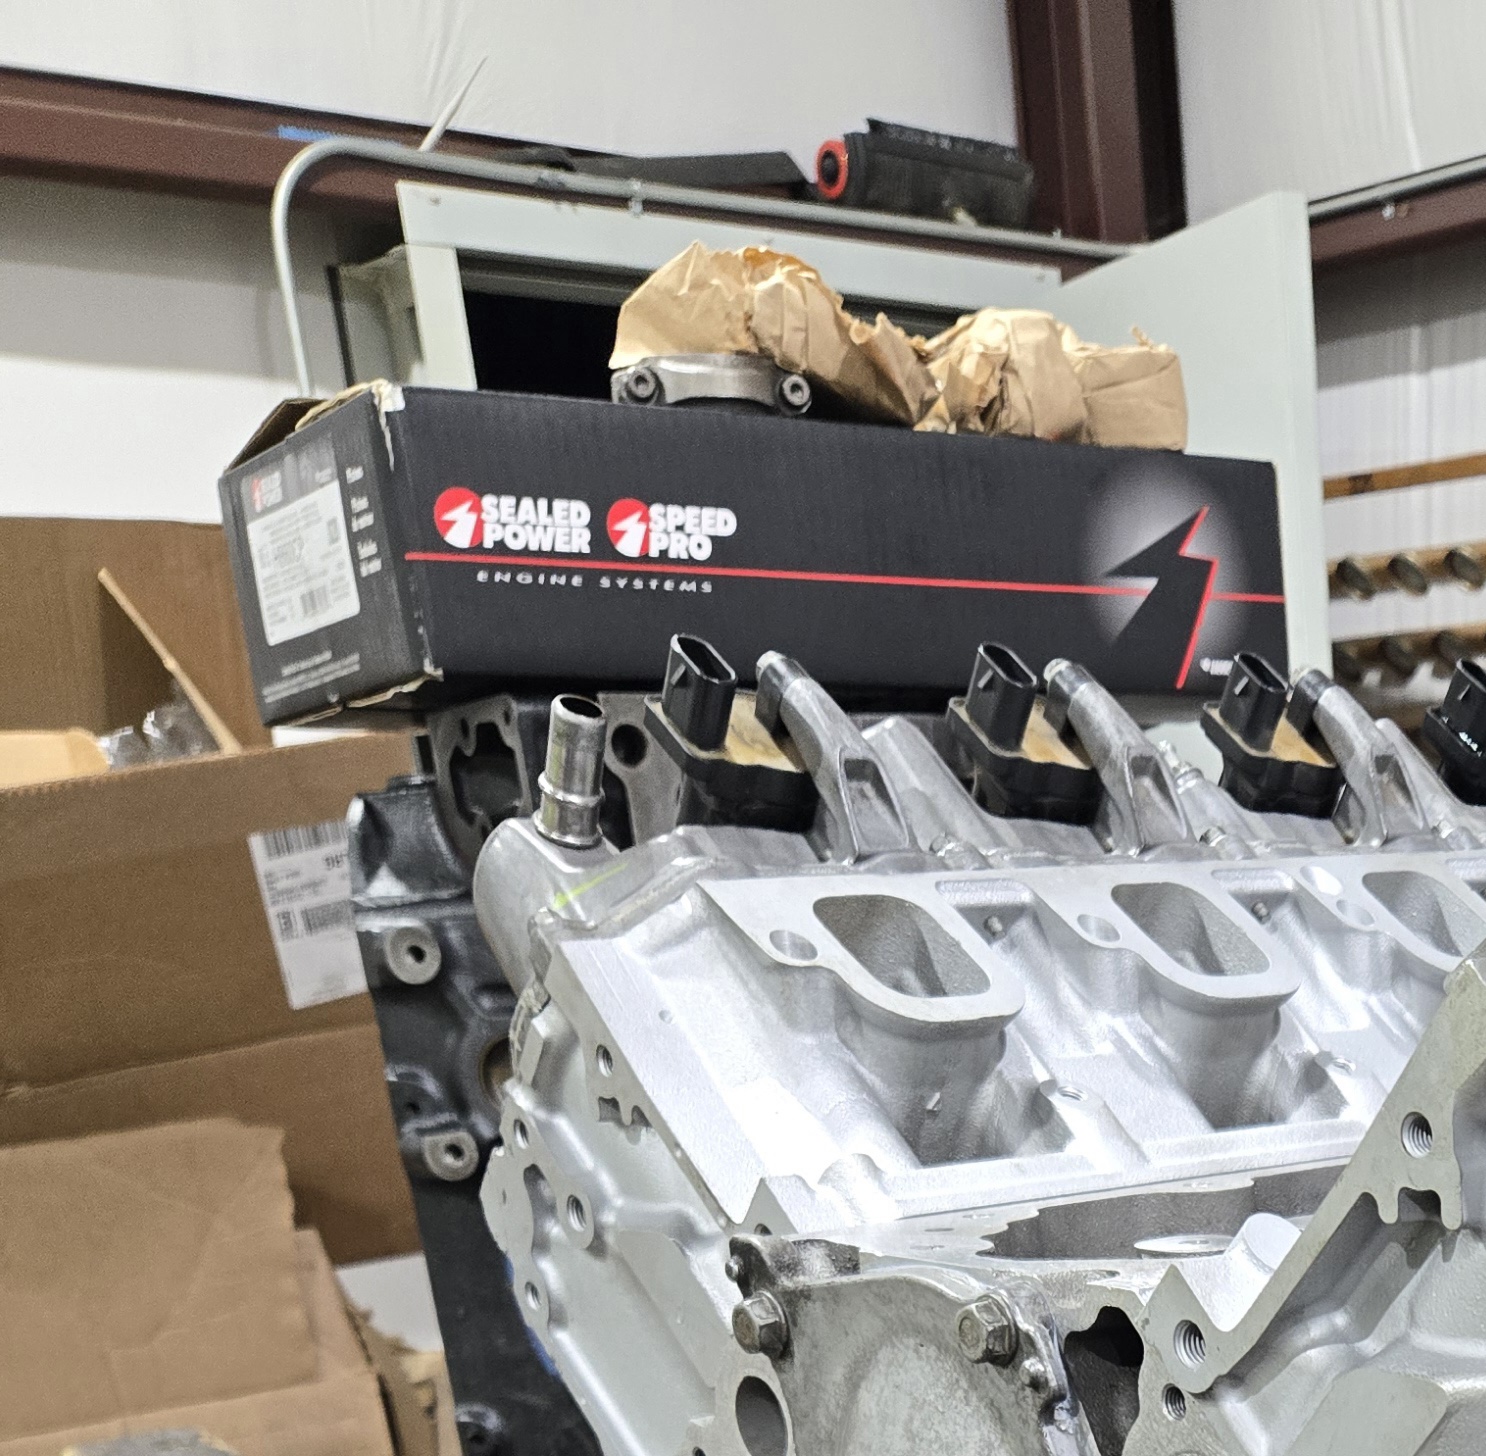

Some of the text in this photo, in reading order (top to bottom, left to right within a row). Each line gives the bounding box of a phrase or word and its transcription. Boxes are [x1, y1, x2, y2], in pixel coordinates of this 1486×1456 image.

[481, 493, 592, 527] SEALED
[648, 503, 738, 537] SPEED
[482, 522, 592, 554] POWER
[648, 531, 713, 561] PRO
[476, 570, 713, 593] ENGINE SYSTEMS
